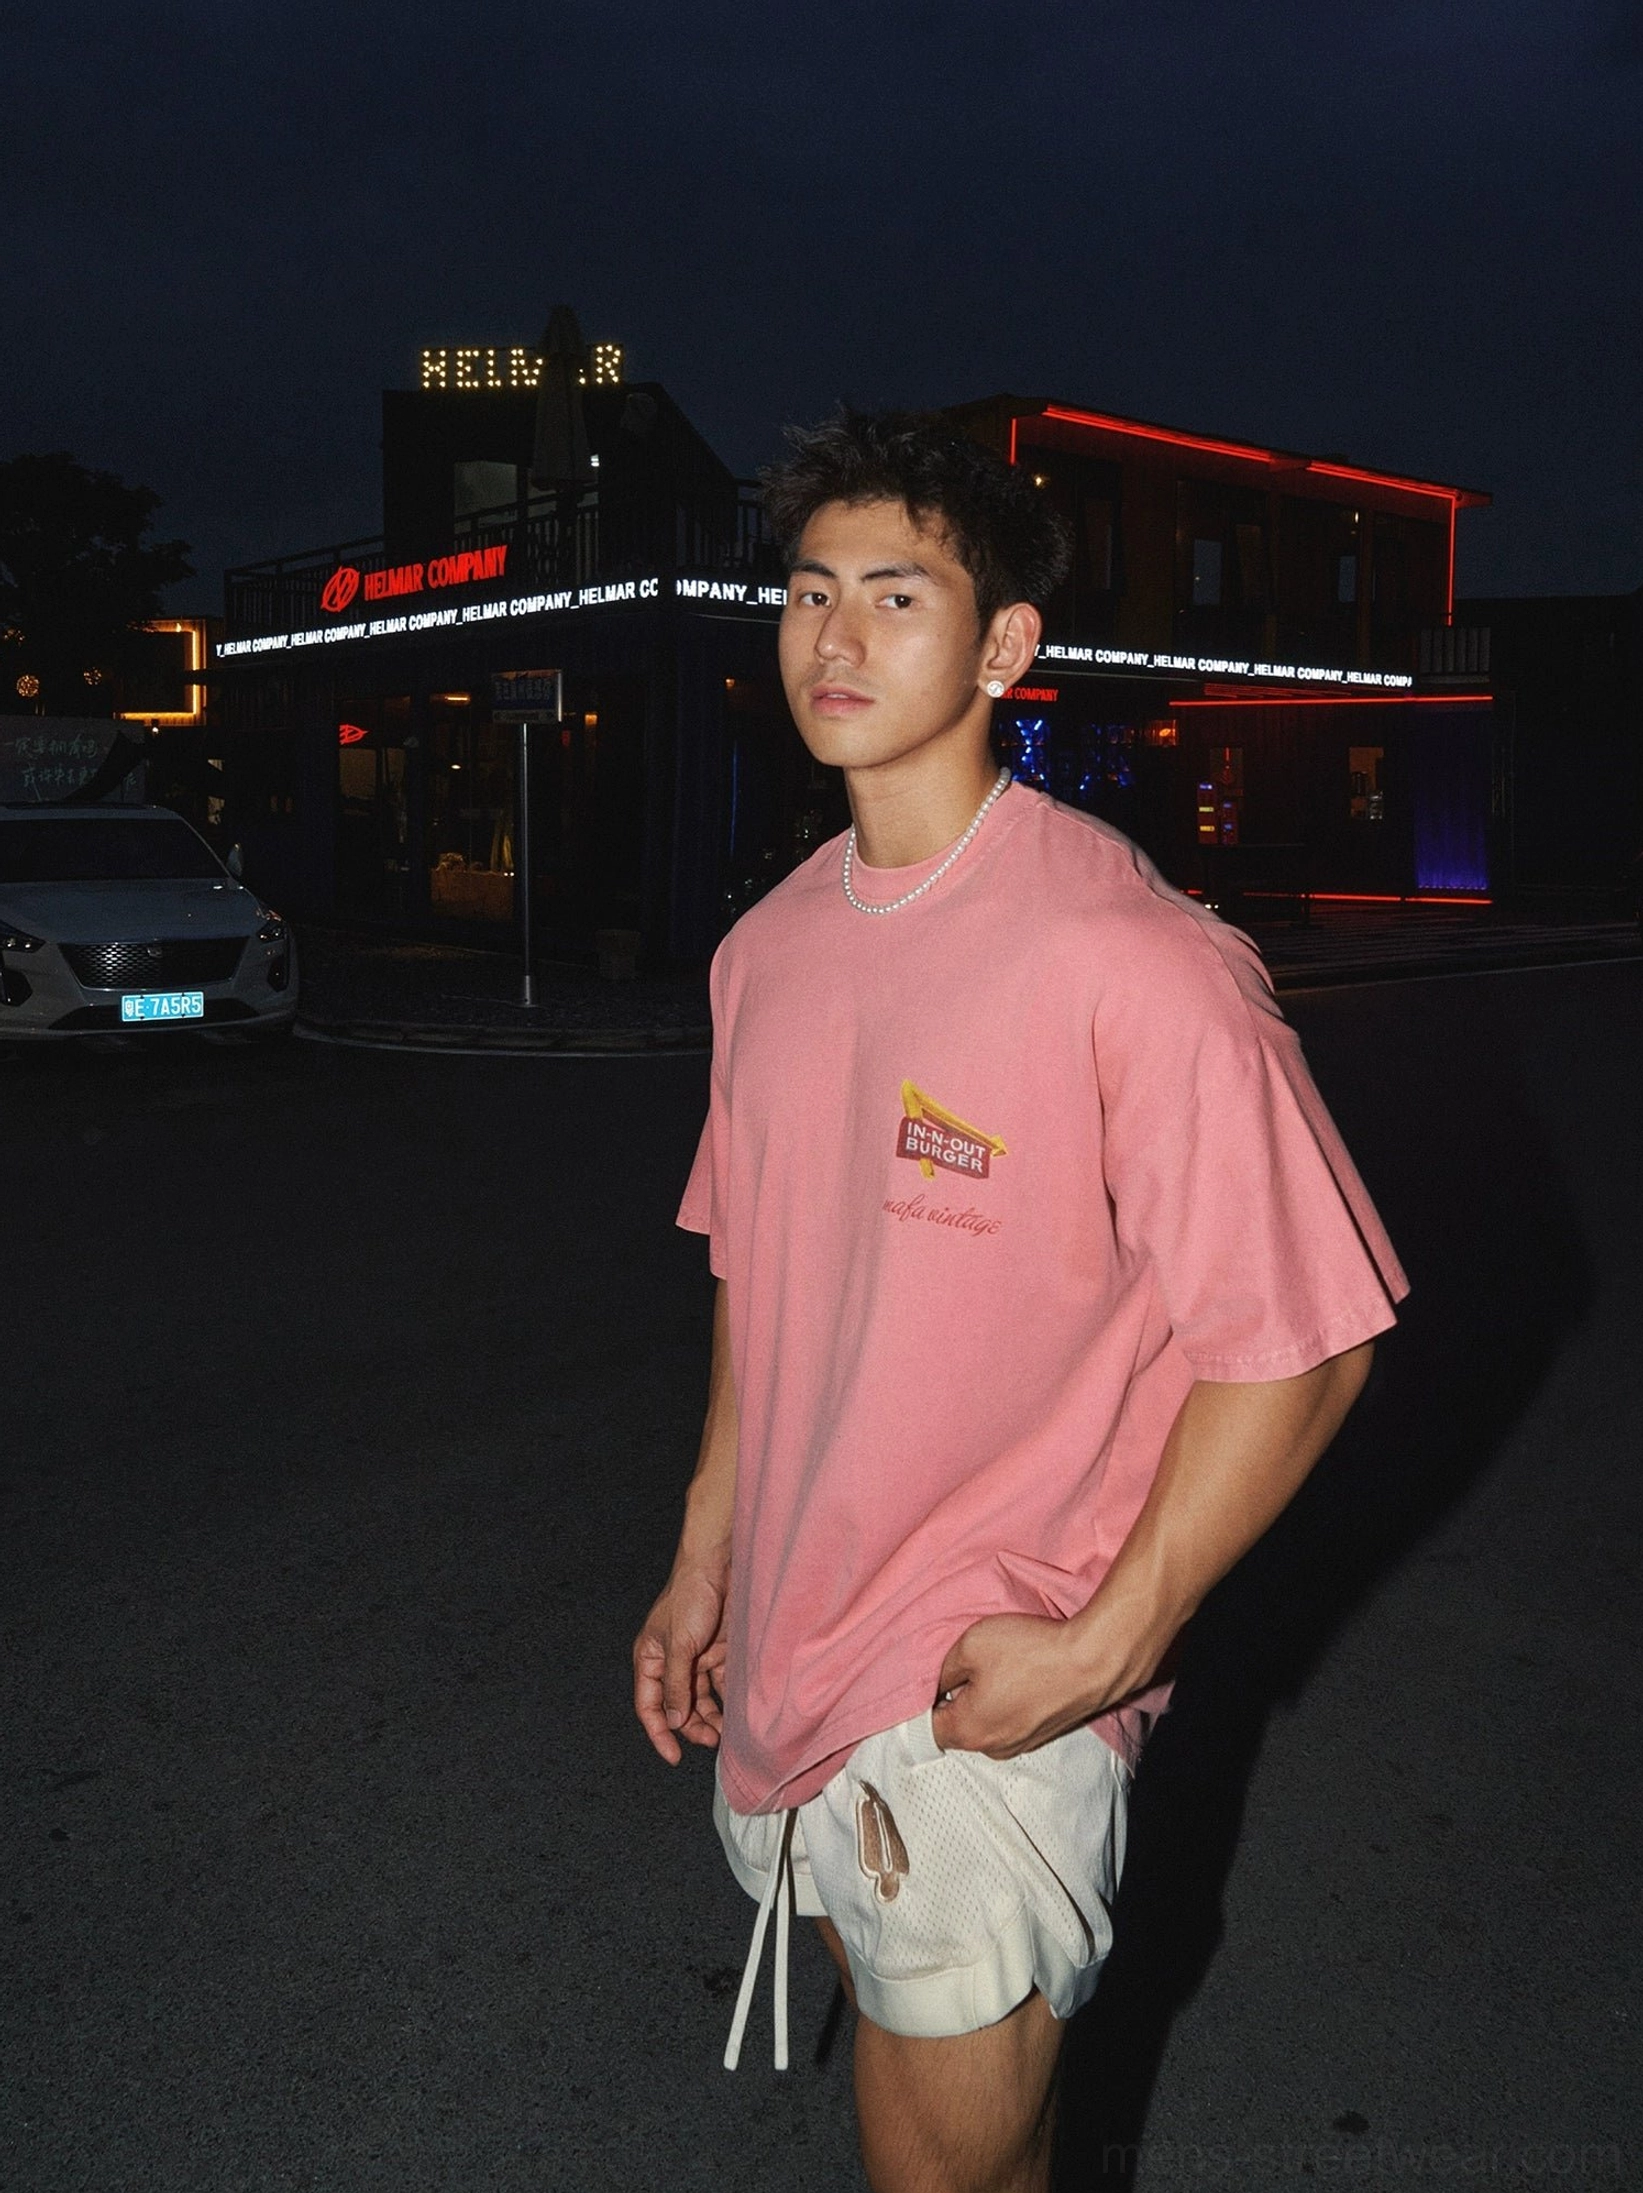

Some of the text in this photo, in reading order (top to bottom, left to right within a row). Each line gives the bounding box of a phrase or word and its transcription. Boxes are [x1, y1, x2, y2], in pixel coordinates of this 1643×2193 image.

[423, 345, 621, 387] HELMR
[364, 544, 508, 601] HELMAR COMPANY
[324, 616, 408, 644] COMPANY_HELMAR
[408, 599, 508, 631] COMPANY_HELMAR
[509, 583, 636, 617] COMPANY_HELMAR
[1094, 648, 1196, 671] COMPANY_HELMAR
[1197, 657, 1296, 679] COMPANY_HELMAR
[1014, 687, 1059, 702] COMPANY
[905, 1137, 983, 1173] BURGER
[907, 1121, 986, 1159] IN-N-OUT
[927, 1206, 1002, 1237] vintage
